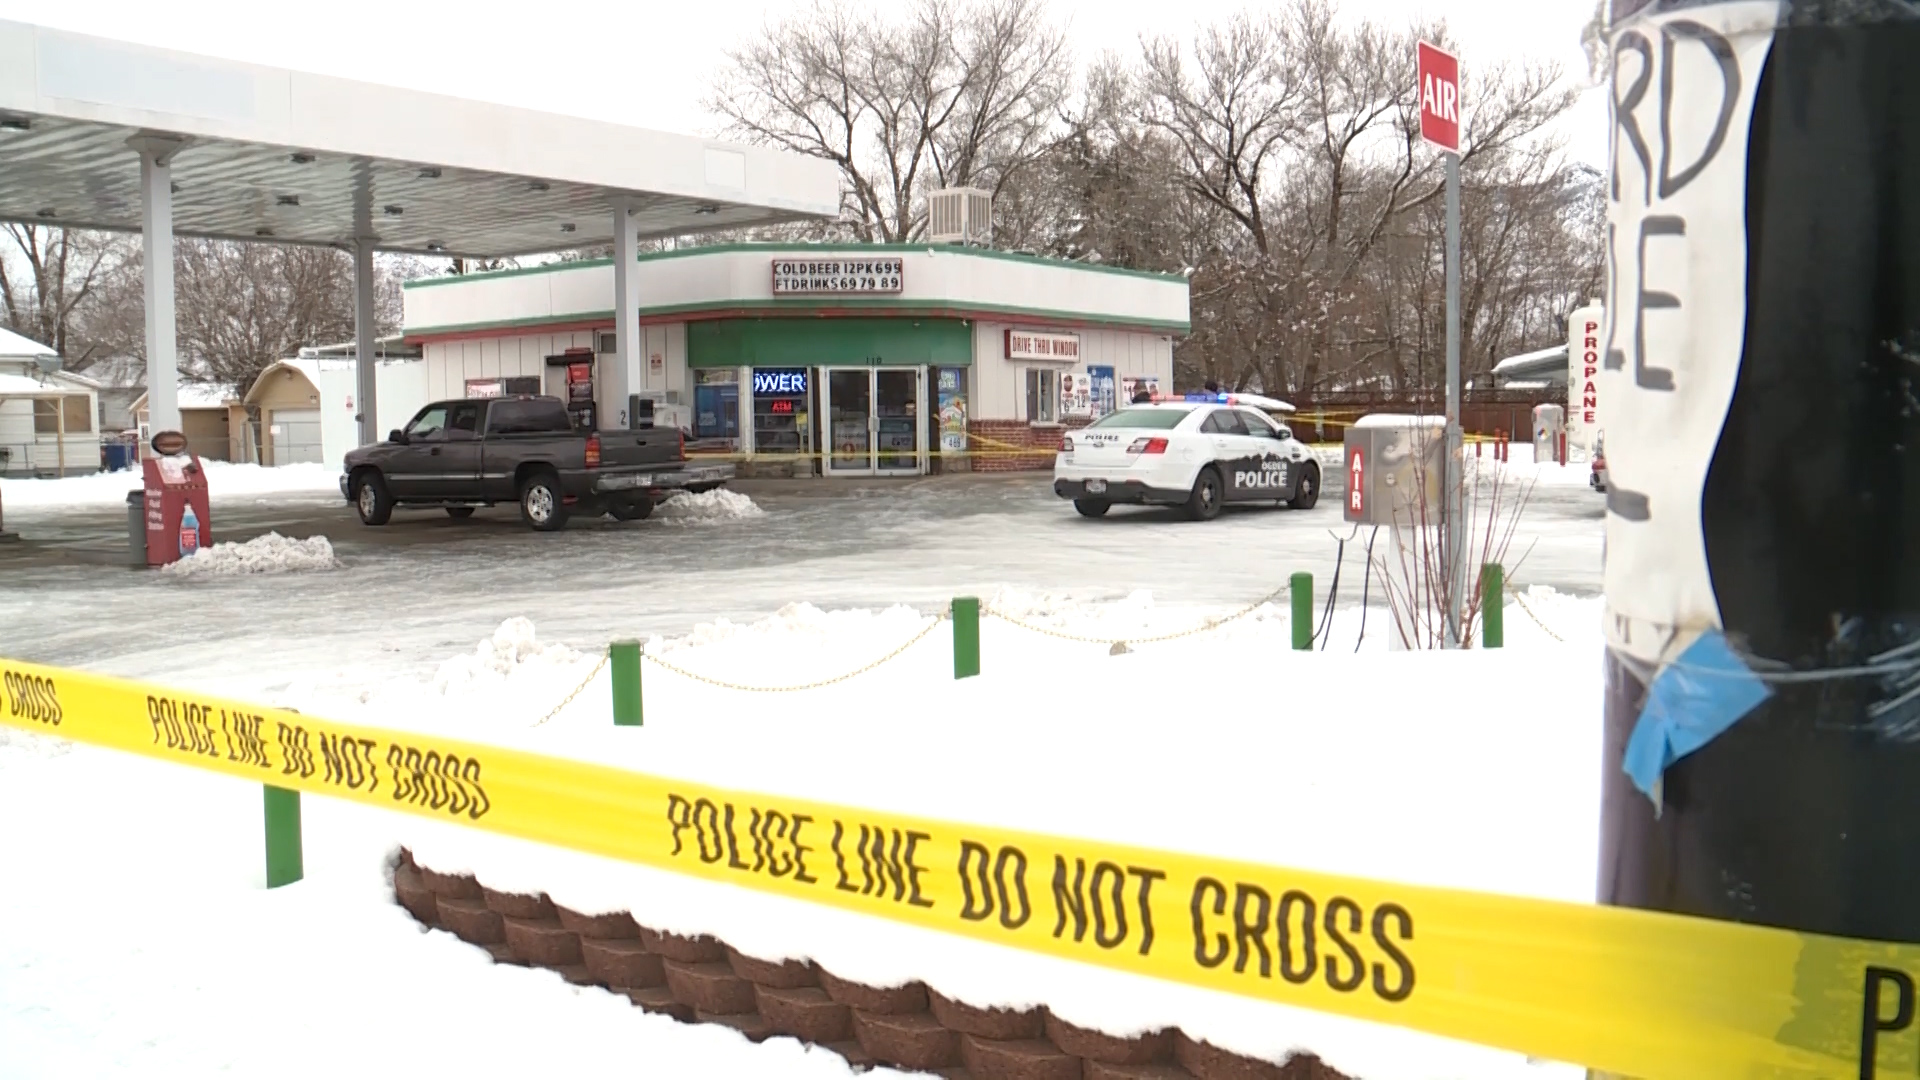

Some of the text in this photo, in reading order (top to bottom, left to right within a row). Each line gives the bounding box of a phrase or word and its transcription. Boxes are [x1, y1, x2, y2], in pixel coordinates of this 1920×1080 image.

[1422, 72, 1458, 124] AIR
[1013, 336, 1031, 353] DRIVE
[1053, 340, 1078, 356] WINDOW
[1583, 321, 1598, 423] PROPANE
[620, 409, 627, 426] 2
[1235, 471, 1288, 488] POLICE
[1261, 461, 1287, 470] OGDEN
[1352, 453, 1362, 510] AIR
[4, 670, 62, 726] CROSS
[147, 695, 490, 820] POLICE LINE DO NOT CROSS
[667, 793, 1415, 1003] POLICE LINE DO NOT CROSS
